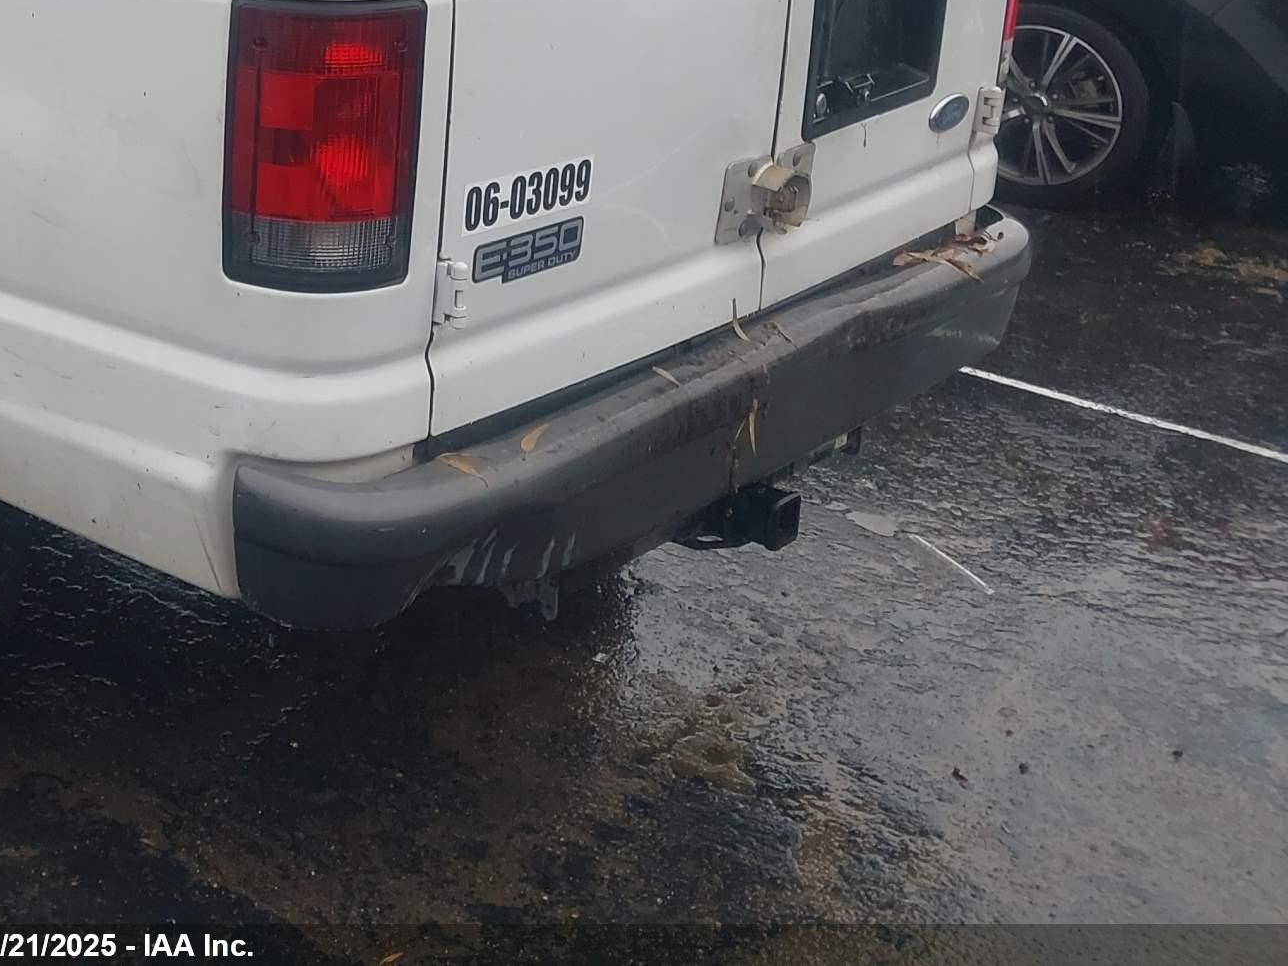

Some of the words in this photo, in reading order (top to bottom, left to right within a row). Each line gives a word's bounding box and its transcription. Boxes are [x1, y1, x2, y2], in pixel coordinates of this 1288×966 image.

[465, 159, 592, 231] 06-03099
[507, 261, 545, 278] SUPER
[547, 250, 577, 267] DUTY
